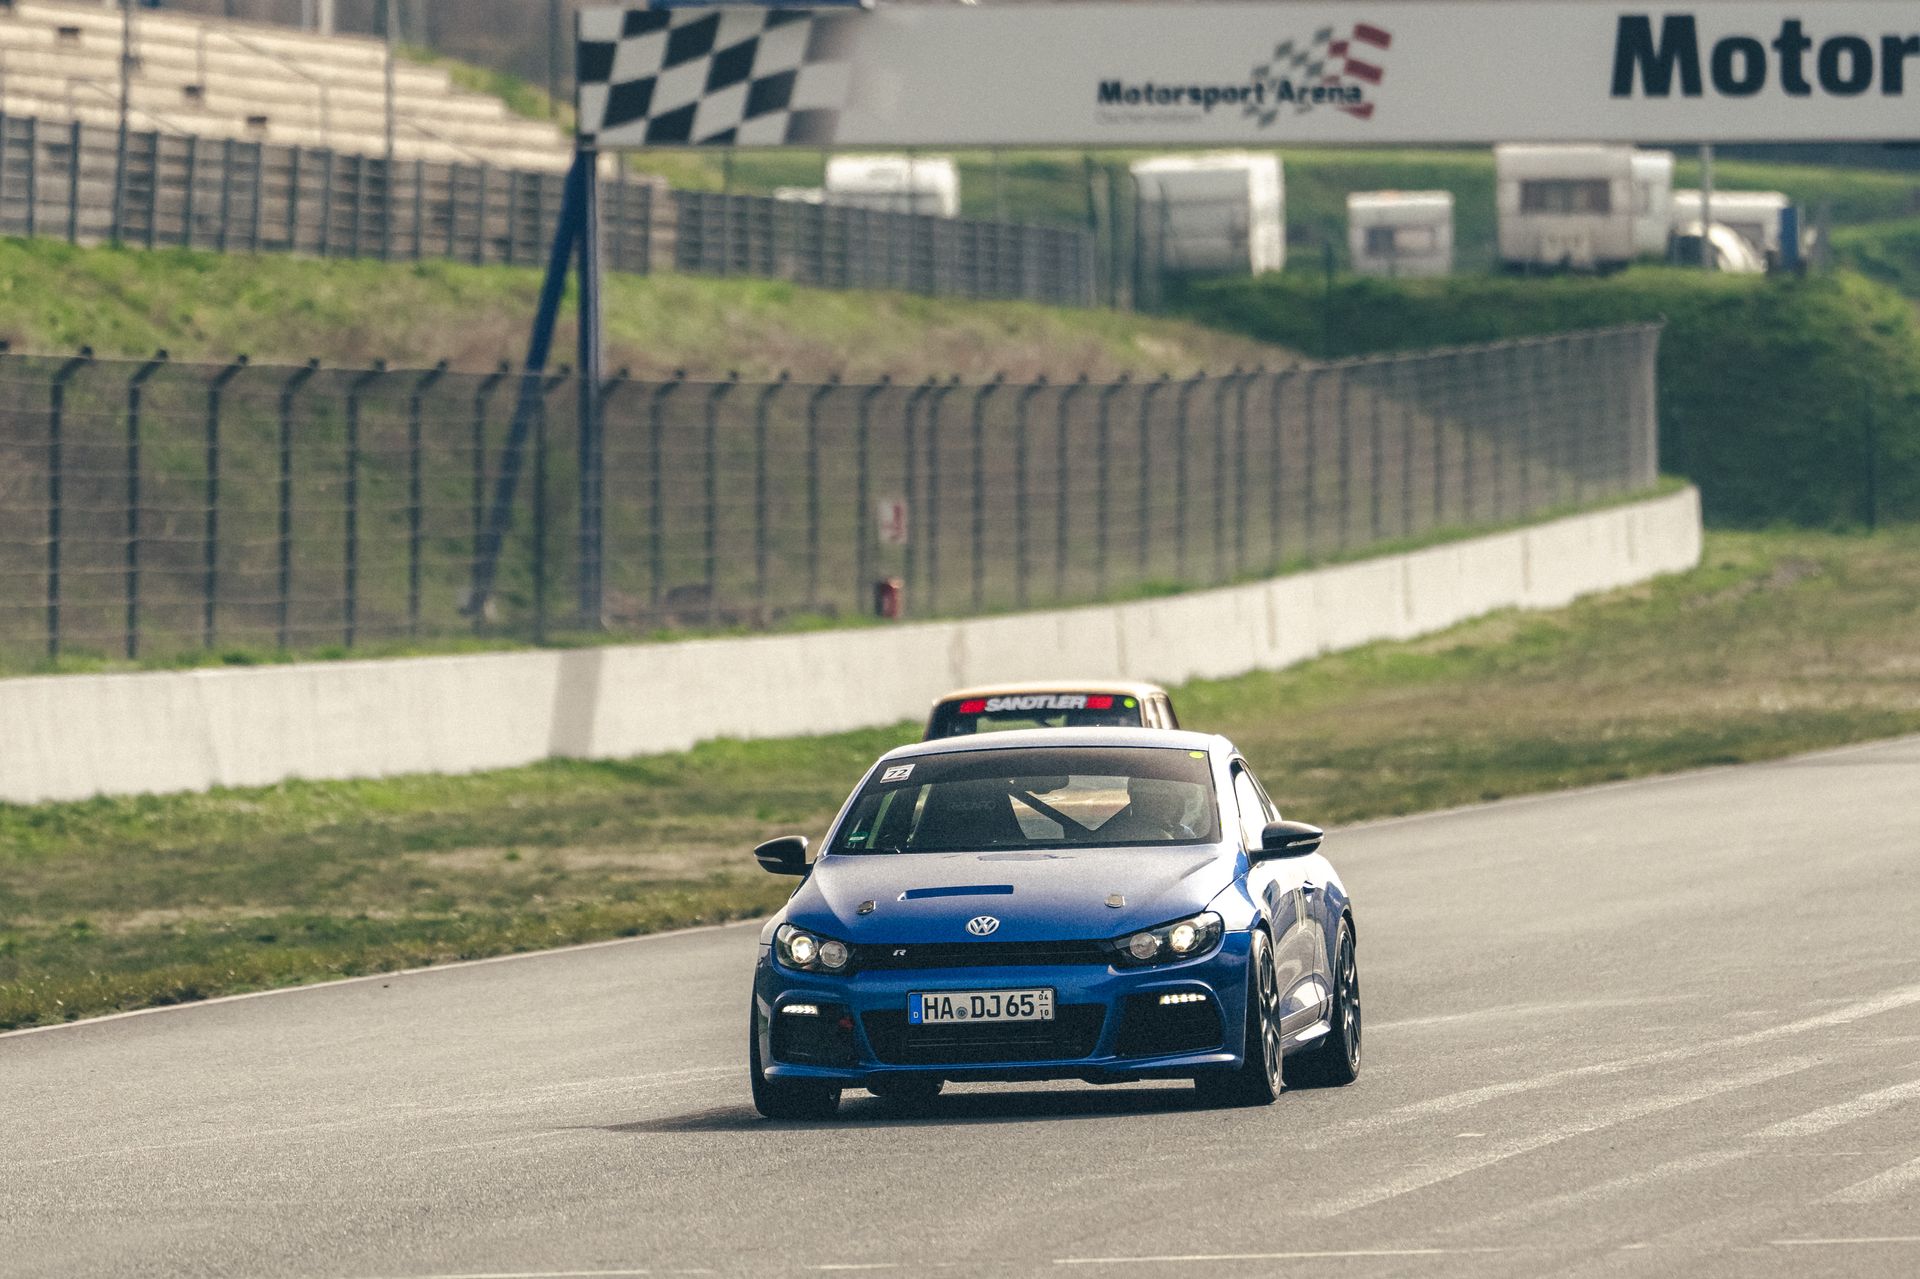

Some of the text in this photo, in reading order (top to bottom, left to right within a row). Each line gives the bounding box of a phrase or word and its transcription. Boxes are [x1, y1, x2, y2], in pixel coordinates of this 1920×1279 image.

[1611, 15, 1920, 97] Motor
[1099, 79, 1362, 111] Motorsport Arena
[985, 695, 1088, 712] SANDTLER
[924, 995, 1034, 1019] HA DJ 65
